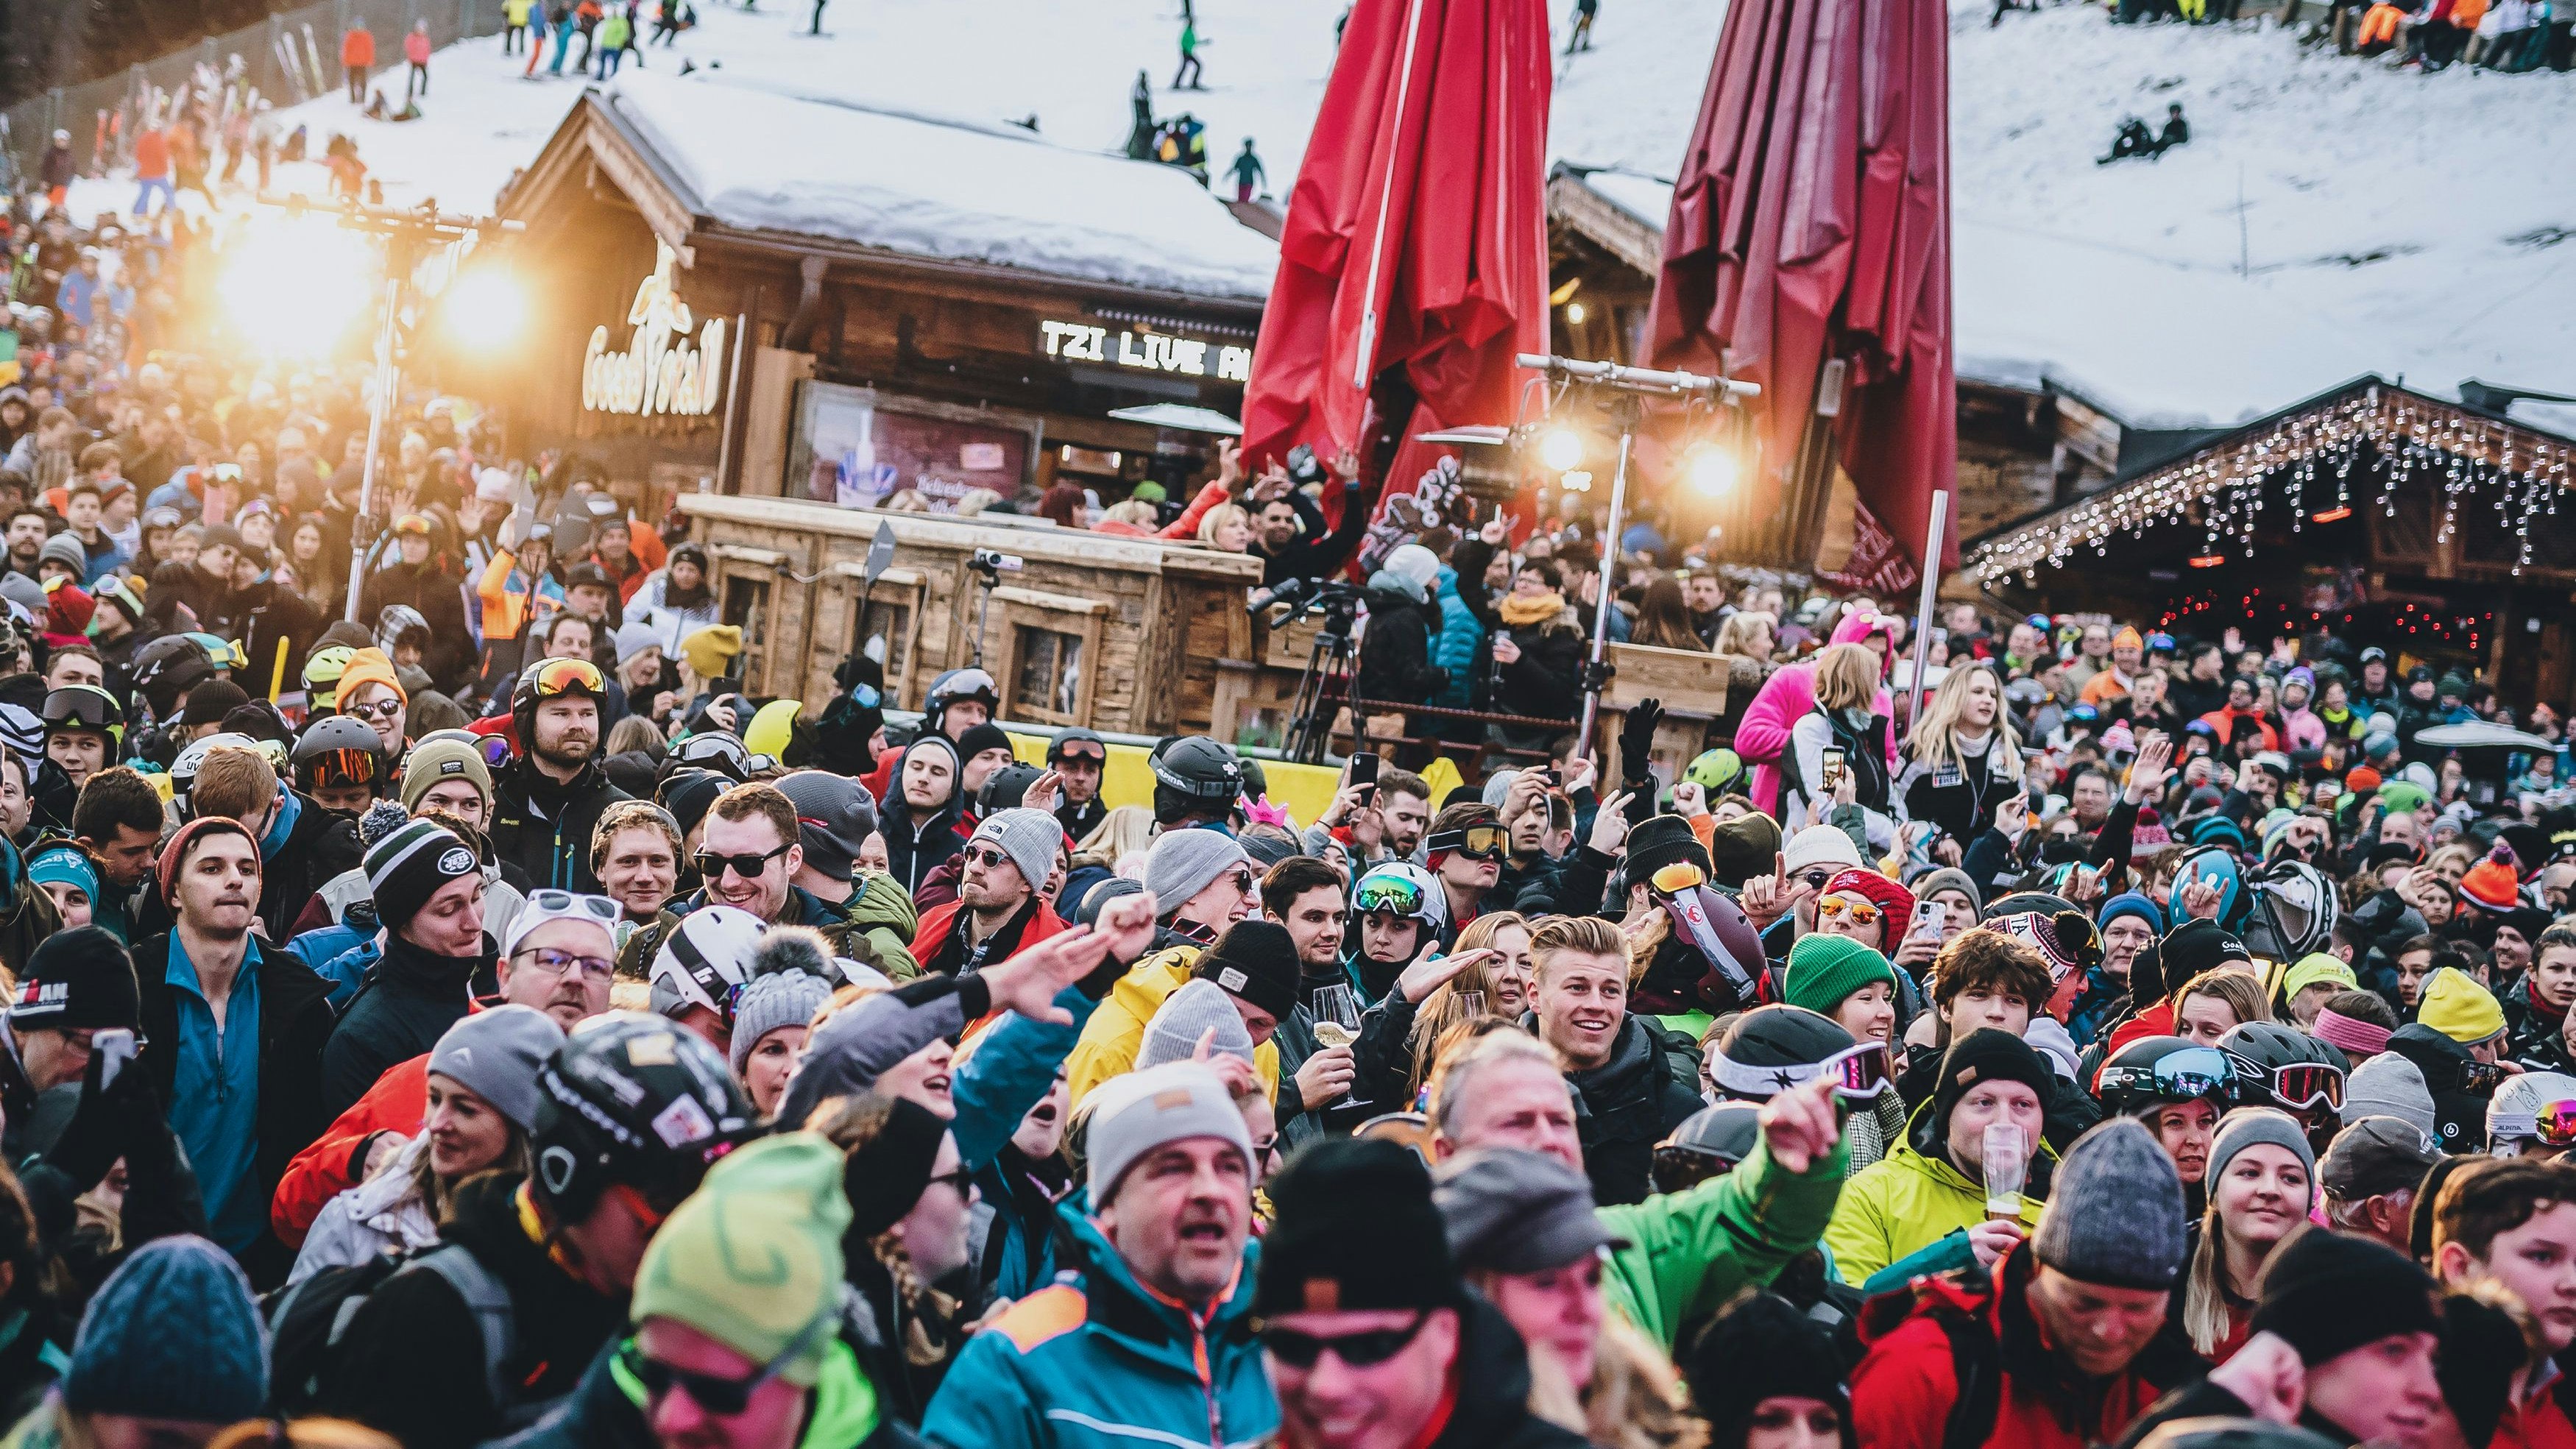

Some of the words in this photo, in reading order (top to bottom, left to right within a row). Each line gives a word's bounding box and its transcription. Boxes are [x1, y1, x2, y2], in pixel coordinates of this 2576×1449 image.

[1041, 320, 1105, 361] TZI
[1118, 331, 1206, 375] LIVE
[1156, 767, 1187, 789] ALPINA
